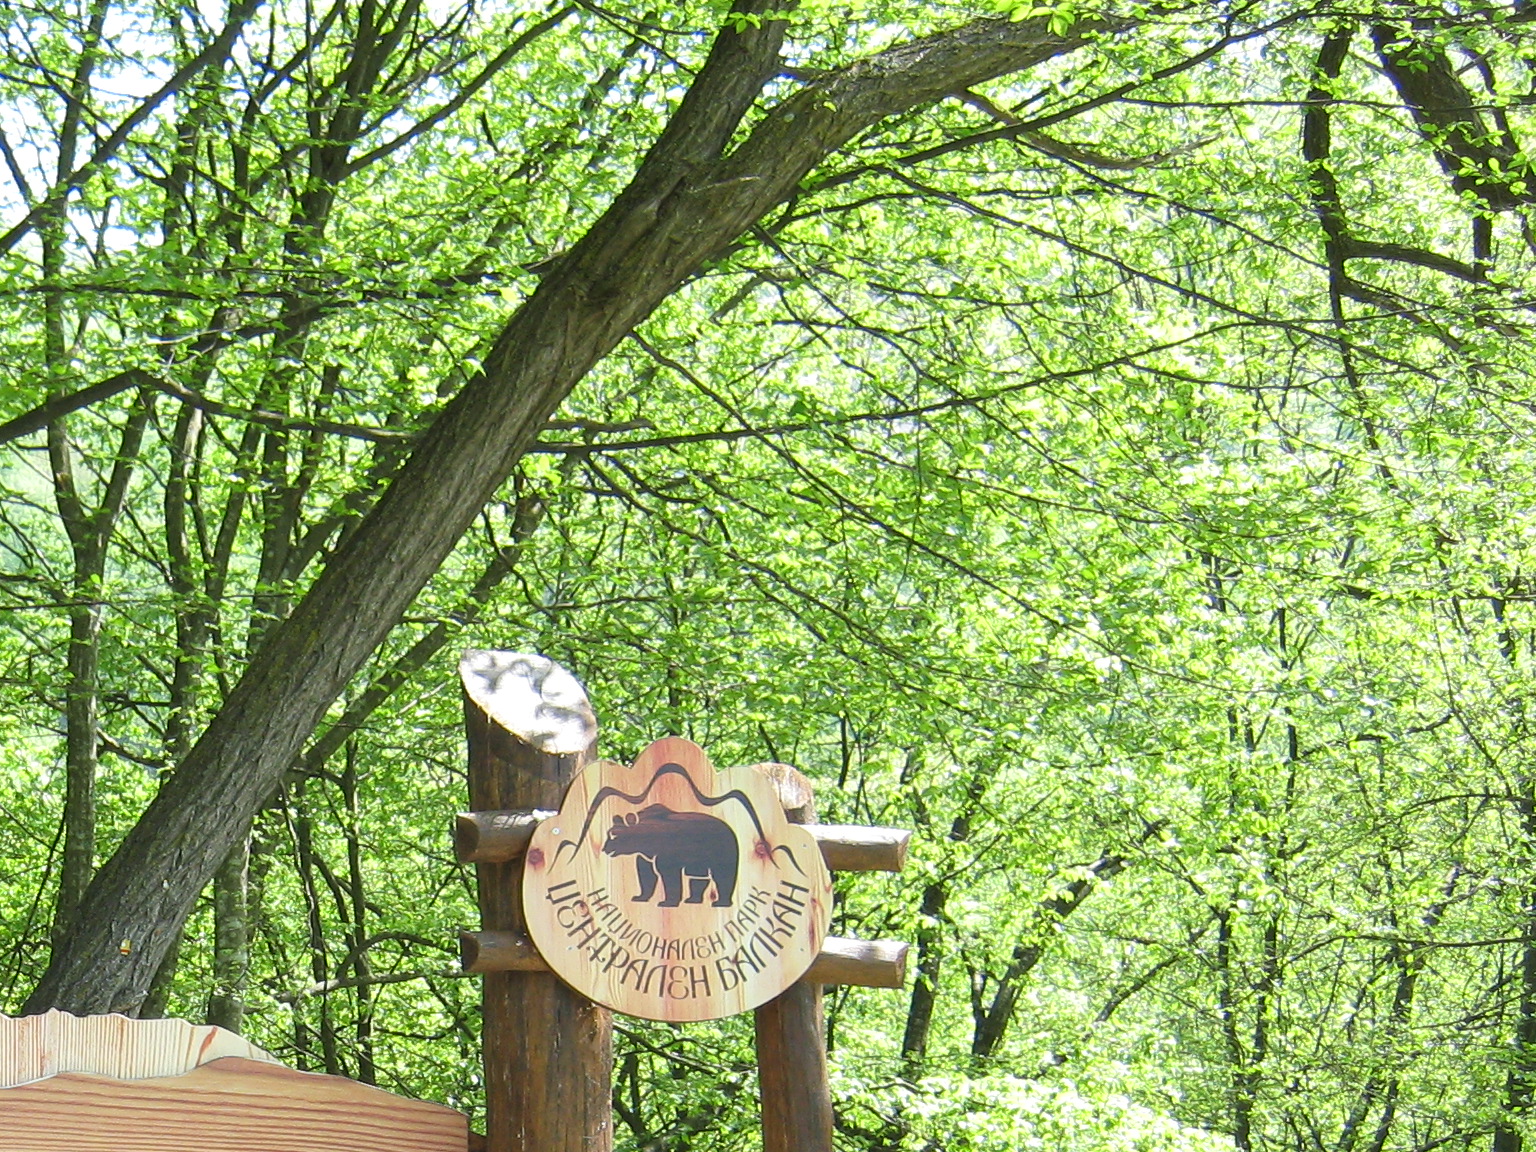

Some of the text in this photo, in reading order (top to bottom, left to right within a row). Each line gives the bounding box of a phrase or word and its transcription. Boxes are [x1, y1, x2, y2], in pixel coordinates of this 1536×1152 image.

[545, 879, 810, 999] ЦЕНТРАЛЕН БАЛКАН
[586, 885, 772, 961] НАЦИОНАЛЕН ПАРК
